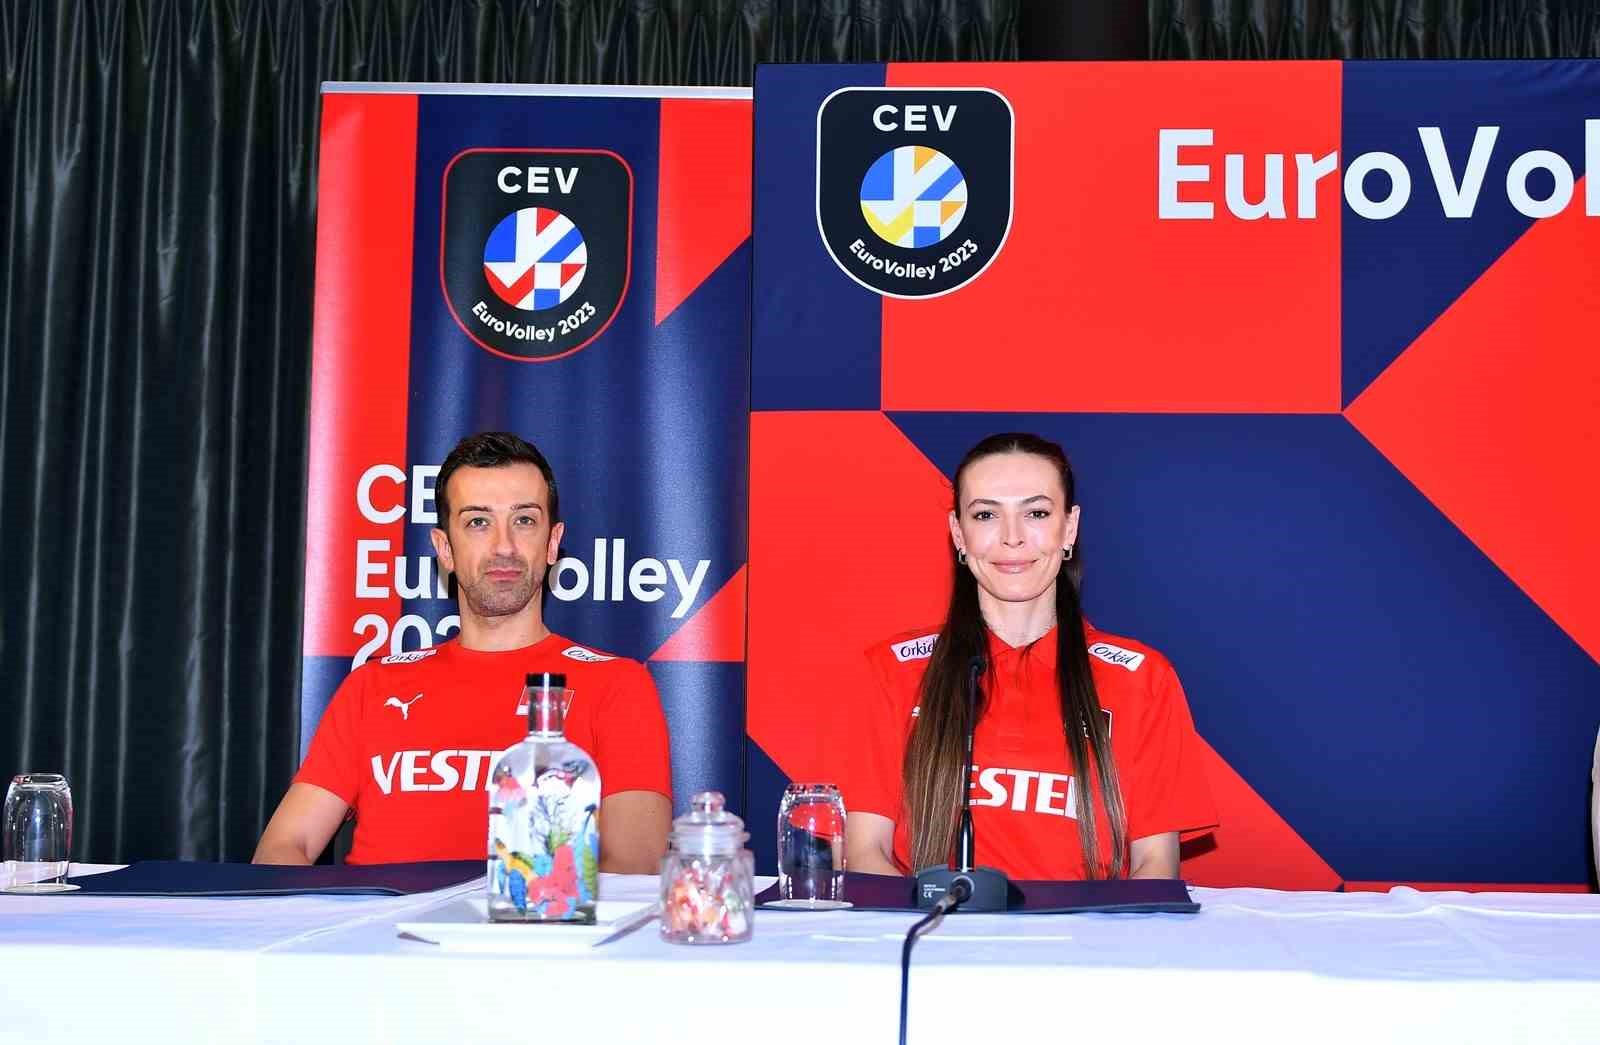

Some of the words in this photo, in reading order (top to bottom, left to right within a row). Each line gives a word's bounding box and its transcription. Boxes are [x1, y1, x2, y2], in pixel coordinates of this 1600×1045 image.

[872, 104, 957, 132] CEV
[497, 166, 579, 194] CEV
[1158, 119, 1600, 220] EuroVol
[849, 238, 936, 280] EuroVolley
[938, 238, 979, 273] 2023
[471, 300, 555, 343] EuroVolley
[557, 301, 597, 336] 2023
[356, 464, 442, 524] CE
[1094, 646, 1138, 665] Orkid
[371, 749, 504, 795] VEST
